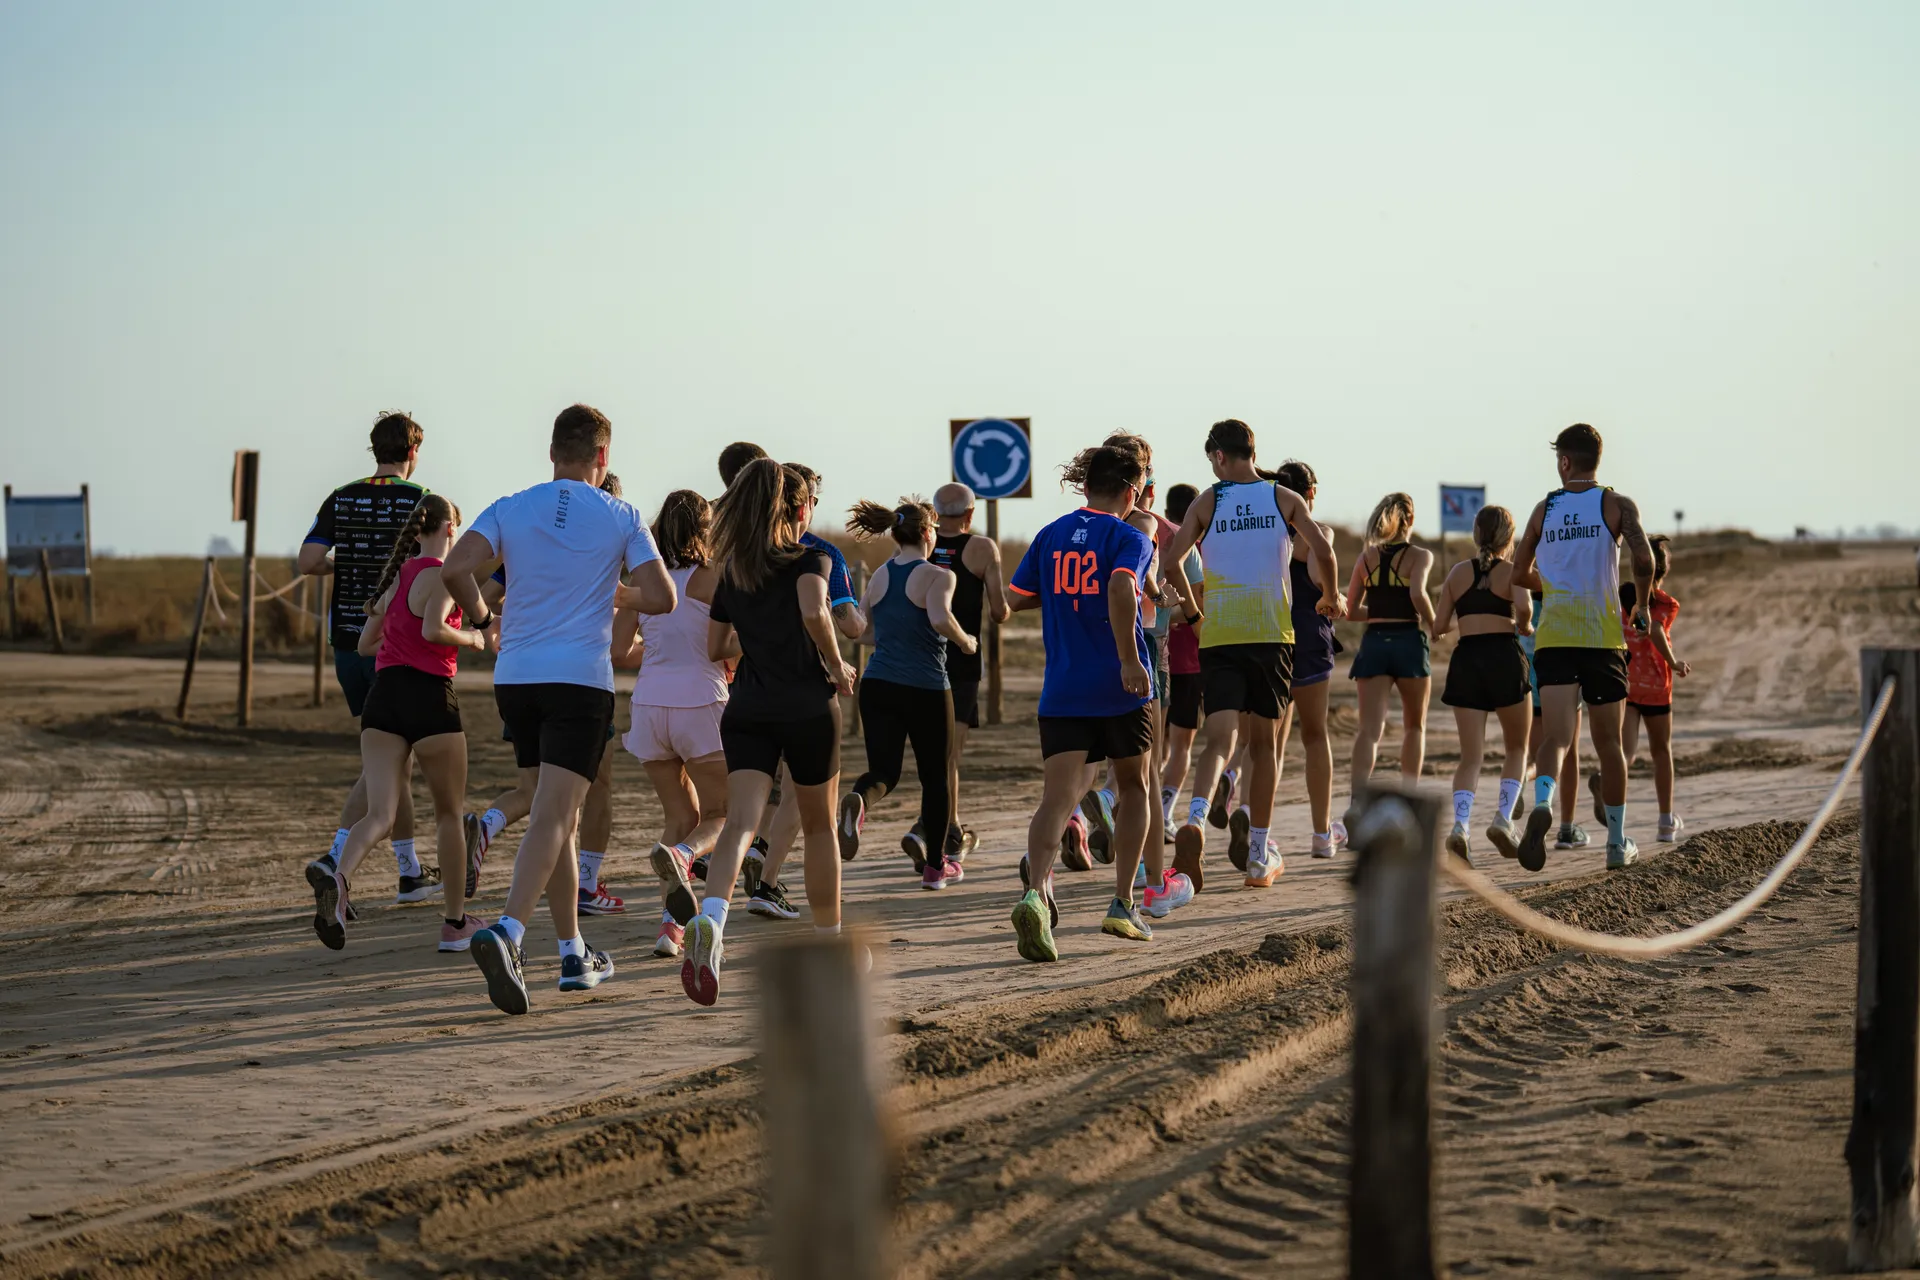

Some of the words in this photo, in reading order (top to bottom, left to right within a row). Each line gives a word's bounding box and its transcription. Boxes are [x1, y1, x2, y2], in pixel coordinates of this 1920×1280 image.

[555, 490, 569, 529] ENDLESS
[1236, 504, 1254, 516] C.E.
[1216, 520, 1226, 533] LO
[1231, 516, 1276, 532] CARRILET
[1564, 514, 1580, 526] C.E.
[1546, 530, 1556, 543] LO
[1558, 525, 1601, 540] CARRILET
[1053, 550, 1099, 594] 102
